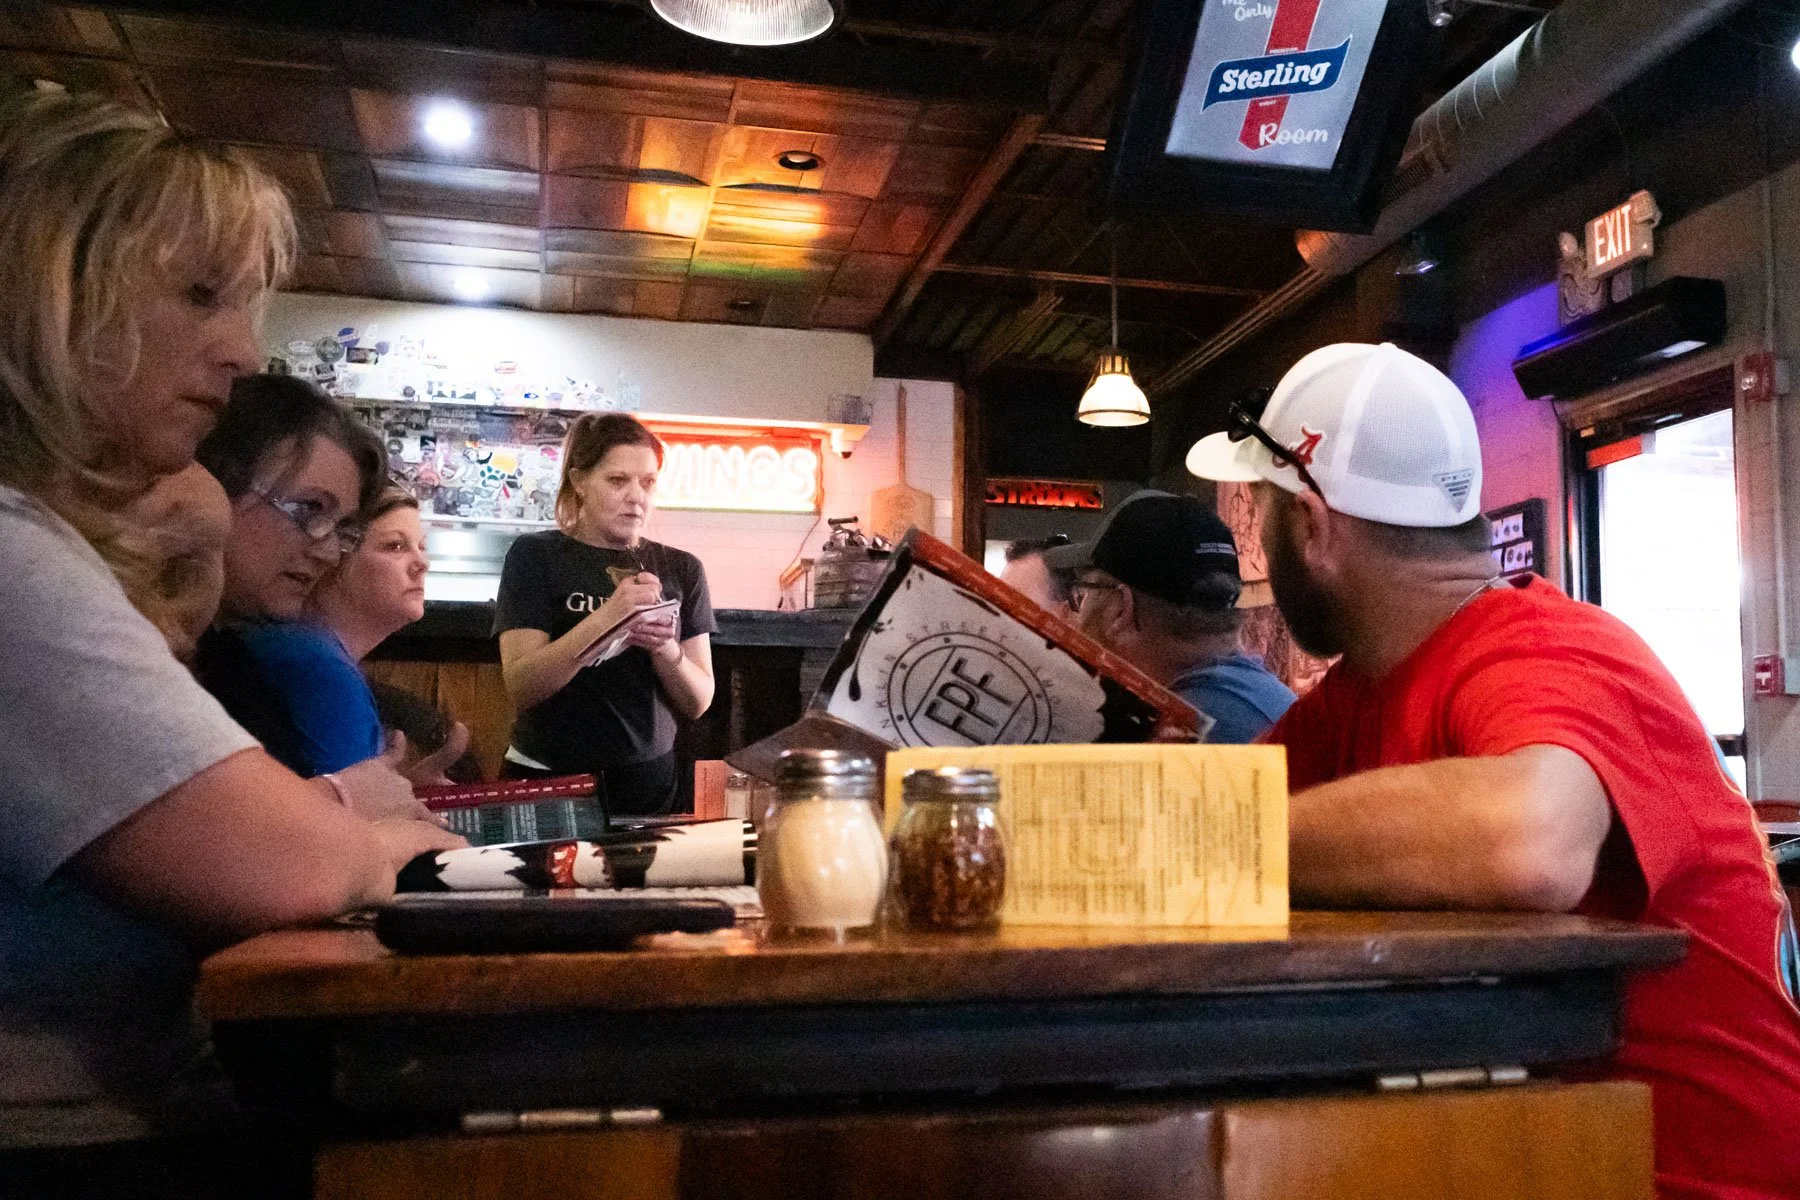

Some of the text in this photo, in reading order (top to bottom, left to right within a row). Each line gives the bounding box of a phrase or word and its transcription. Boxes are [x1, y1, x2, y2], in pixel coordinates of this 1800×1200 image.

[1234, 2, 1272, 21] Only
[1218, 61, 1331, 93] Sterling
[1258, 122, 1329, 146] Room
[1593, 204, 1632, 266] EXIT
[924, 656, 1013, 745] FPF
